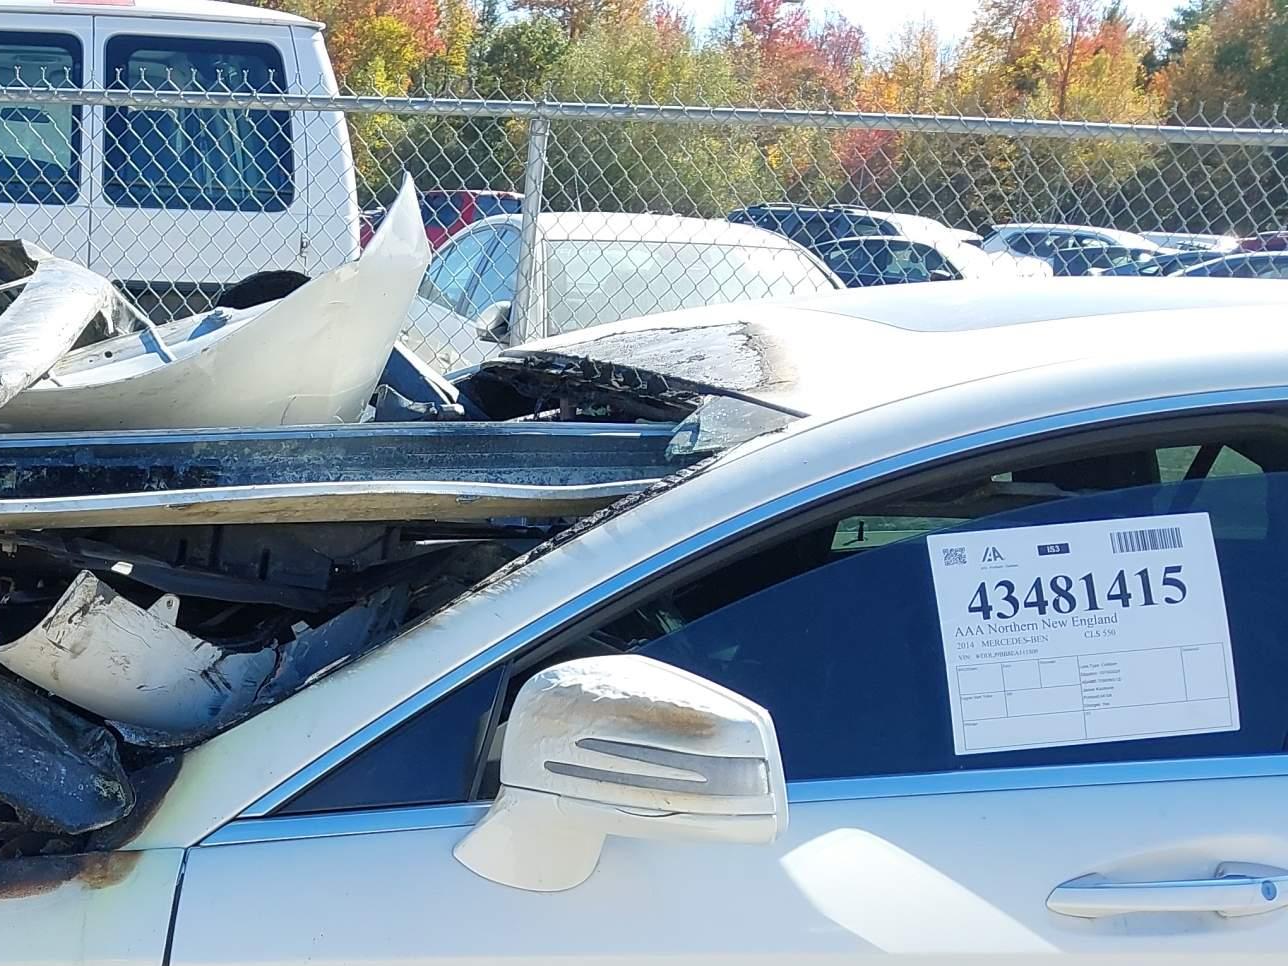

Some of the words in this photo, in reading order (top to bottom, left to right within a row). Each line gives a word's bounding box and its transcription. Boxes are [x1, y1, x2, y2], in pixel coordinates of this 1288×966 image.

[968, 564, 1187, 620] 43481415
[955, 624, 984, 638] AAA
[988, 620, 1039, 635] Northern
[1041, 618, 1068, 630] New
[1072, 613, 1118, 628] England
[957, 641, 975, 650] 2014
